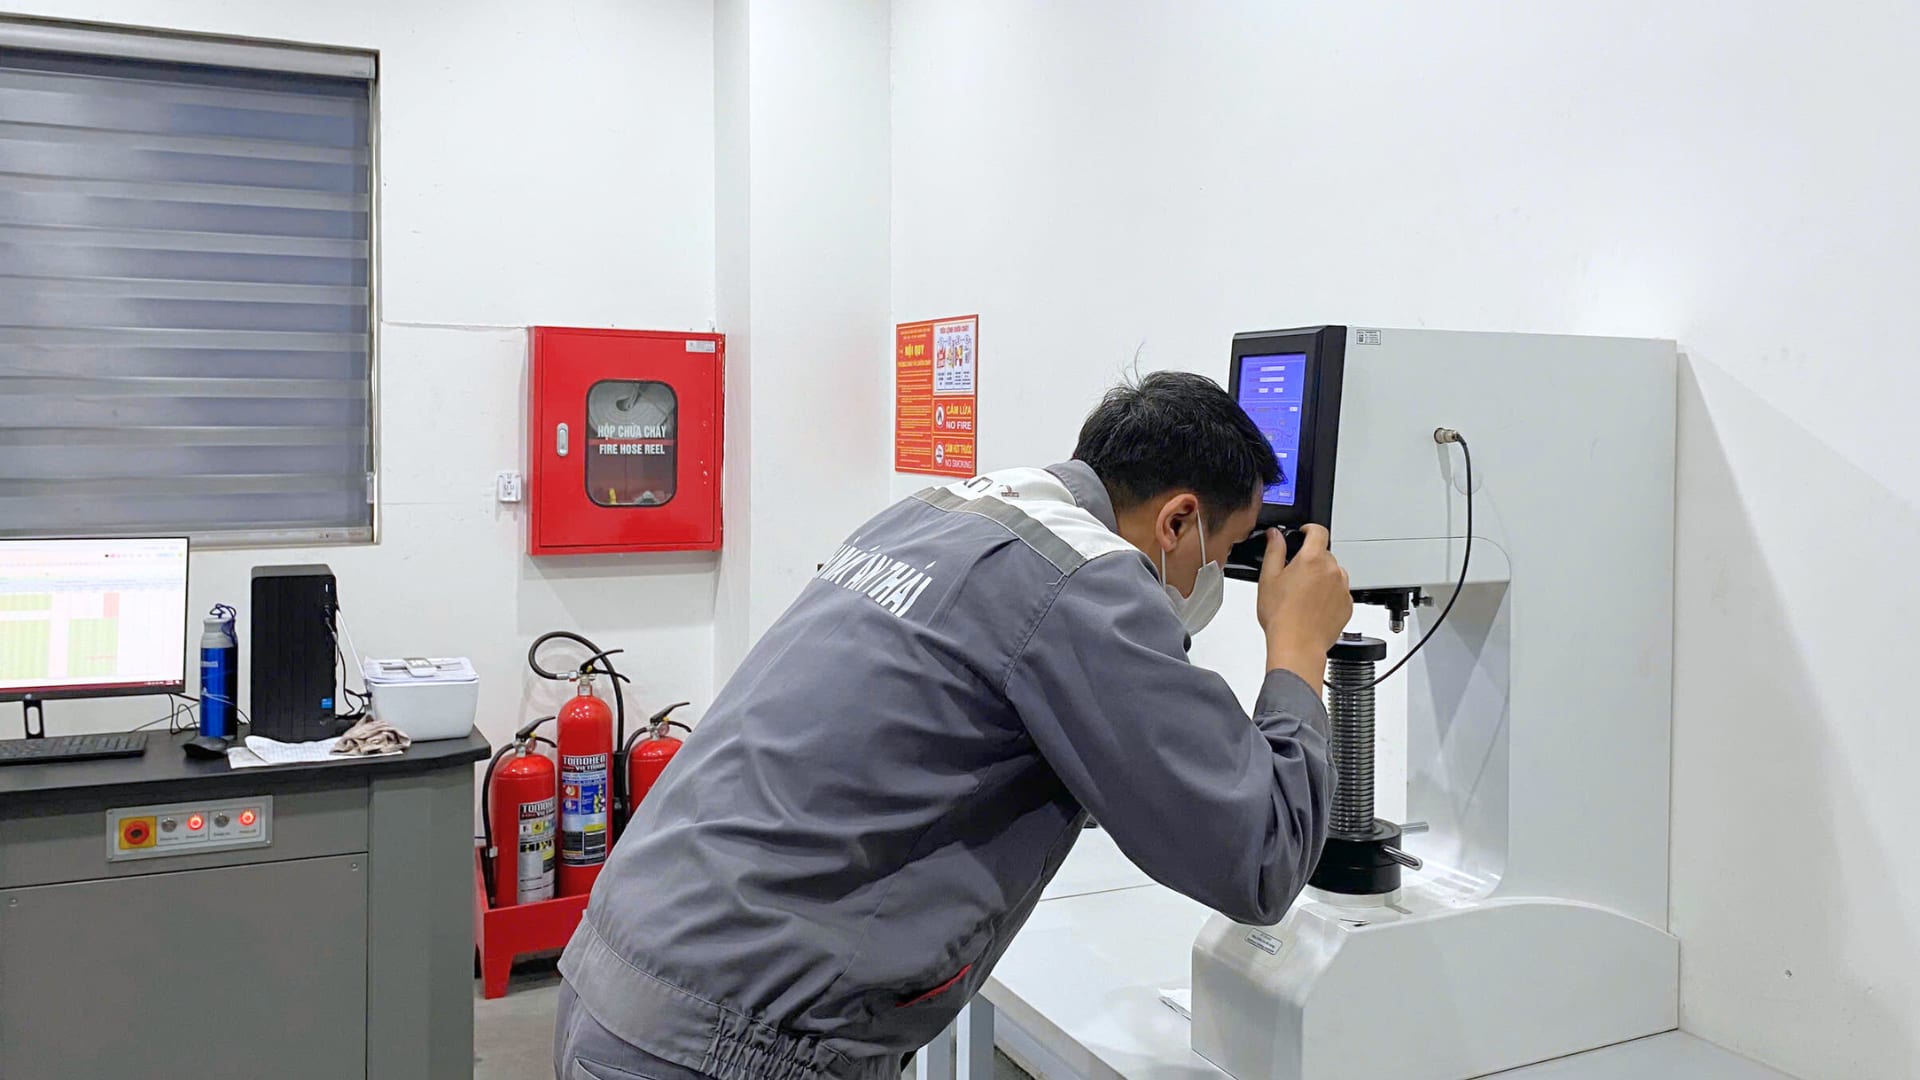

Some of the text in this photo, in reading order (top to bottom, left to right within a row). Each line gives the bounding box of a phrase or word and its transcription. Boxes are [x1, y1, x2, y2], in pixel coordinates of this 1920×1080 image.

[946, 421, 972, 430] NO FIRE
[599, 443, 665, 455] FIRE HOSE REEL
[945, 458, 952, 468] NO
